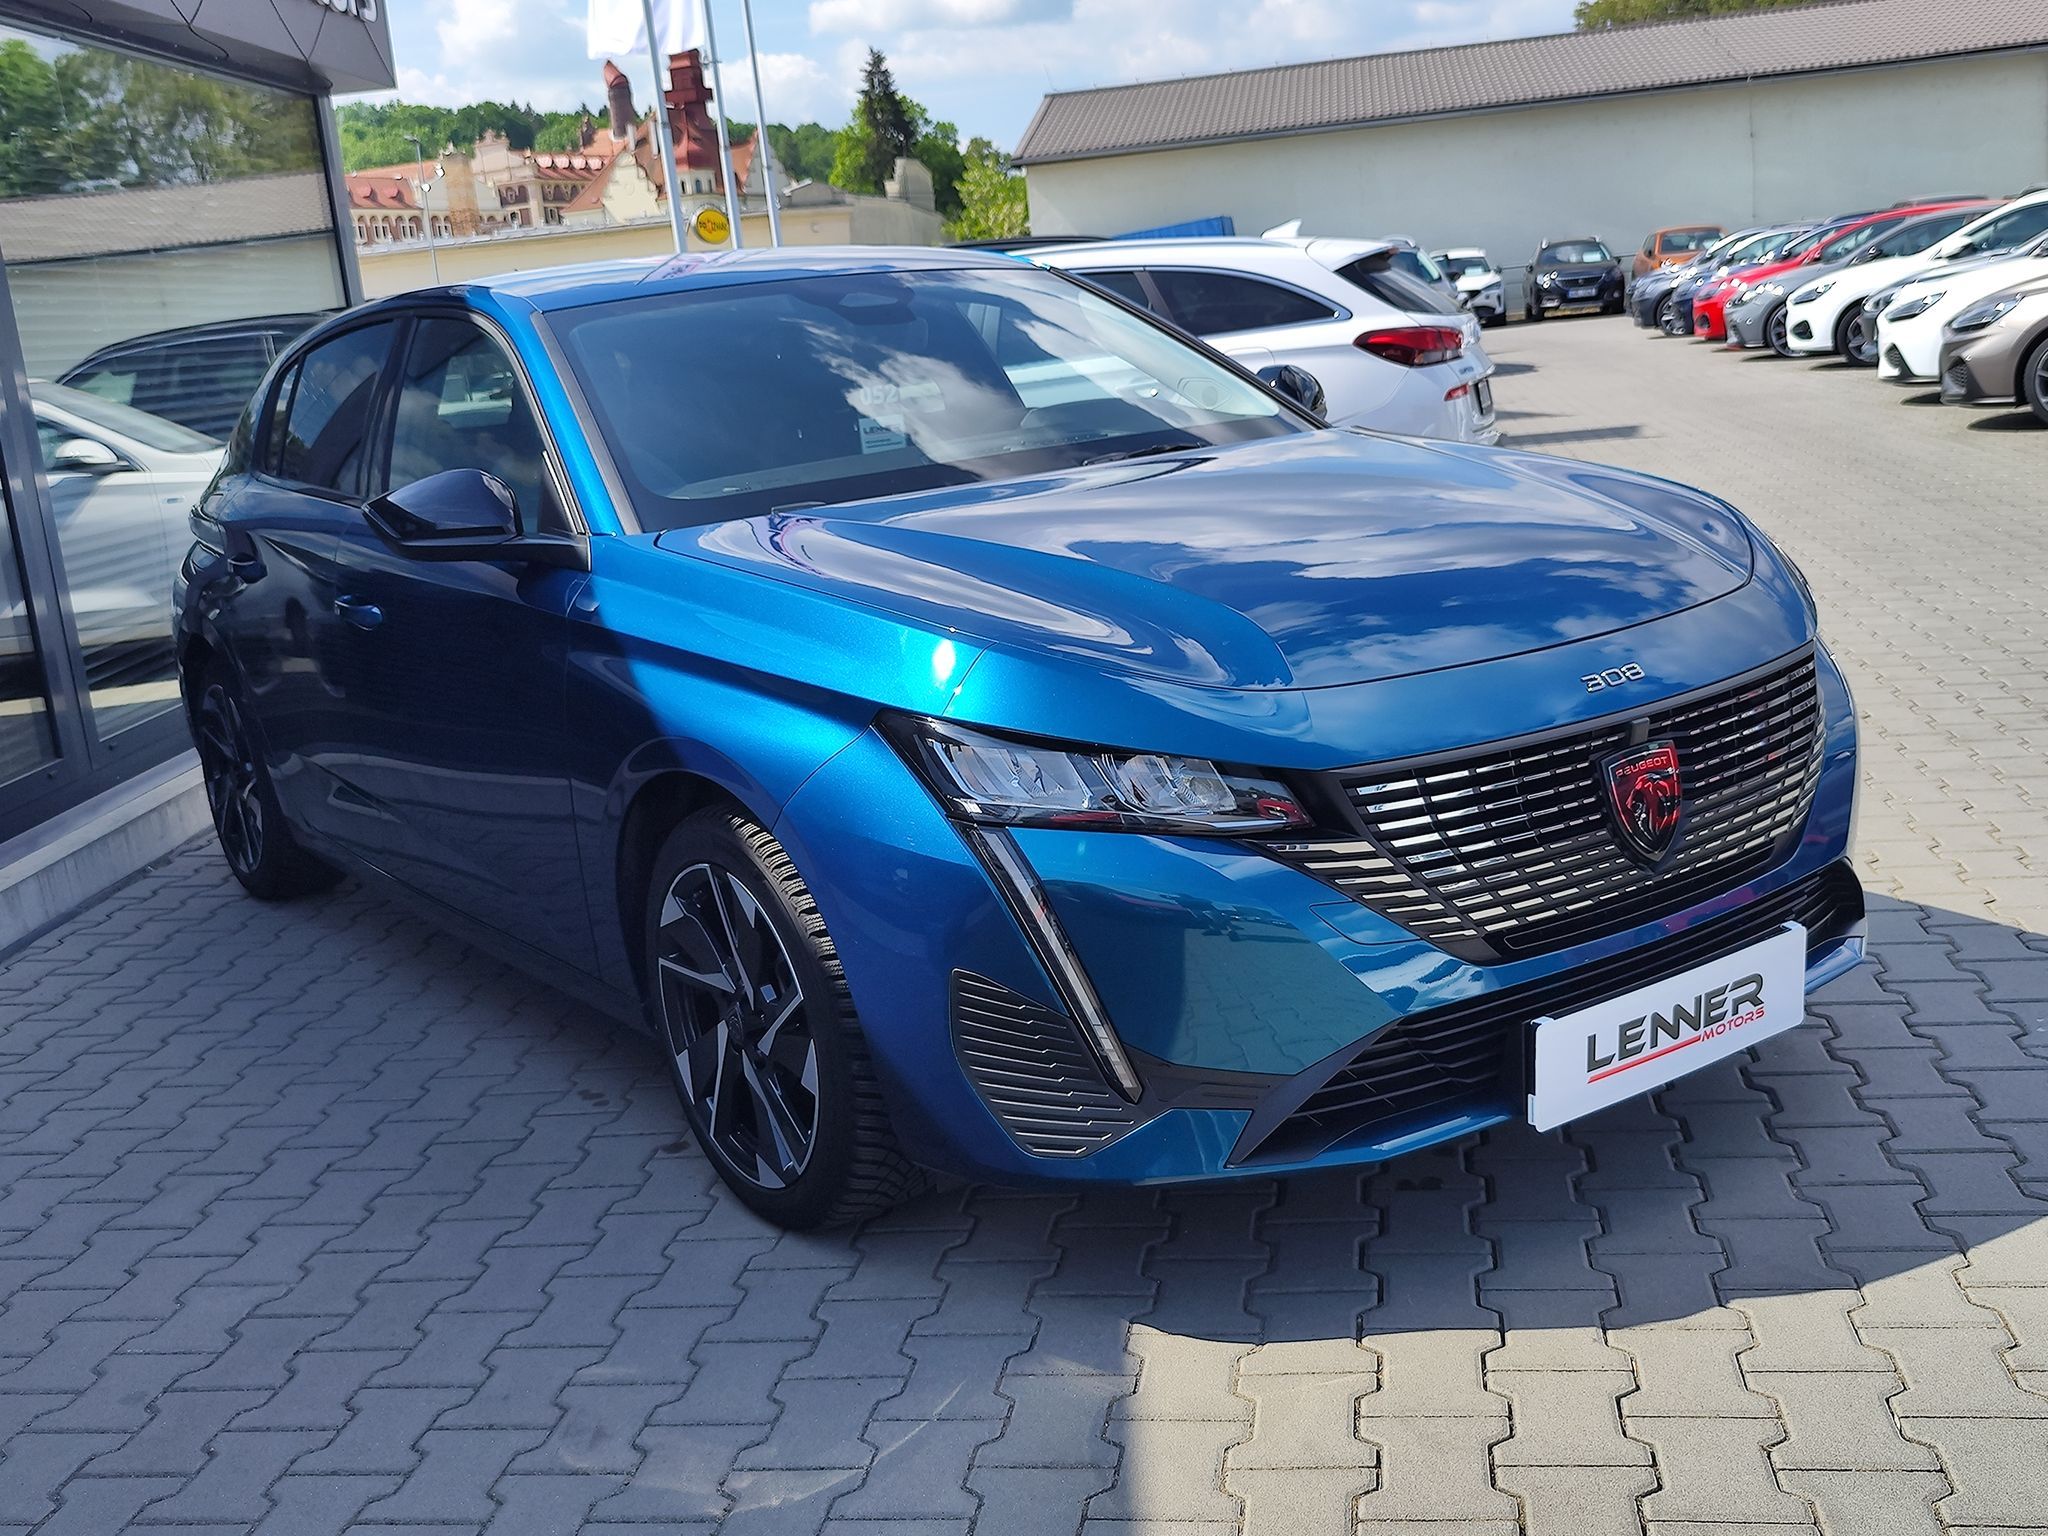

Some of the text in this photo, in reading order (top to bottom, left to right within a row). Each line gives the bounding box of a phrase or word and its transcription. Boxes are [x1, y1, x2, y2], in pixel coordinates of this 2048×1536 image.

[1580, 662, 1645, 693] 308
[1615, 755, 1668, 778] PEUGEOT
[1586, 972, 1764, 1073] LENNER
[1700, 1006, 1765, 1042] MOTORS
